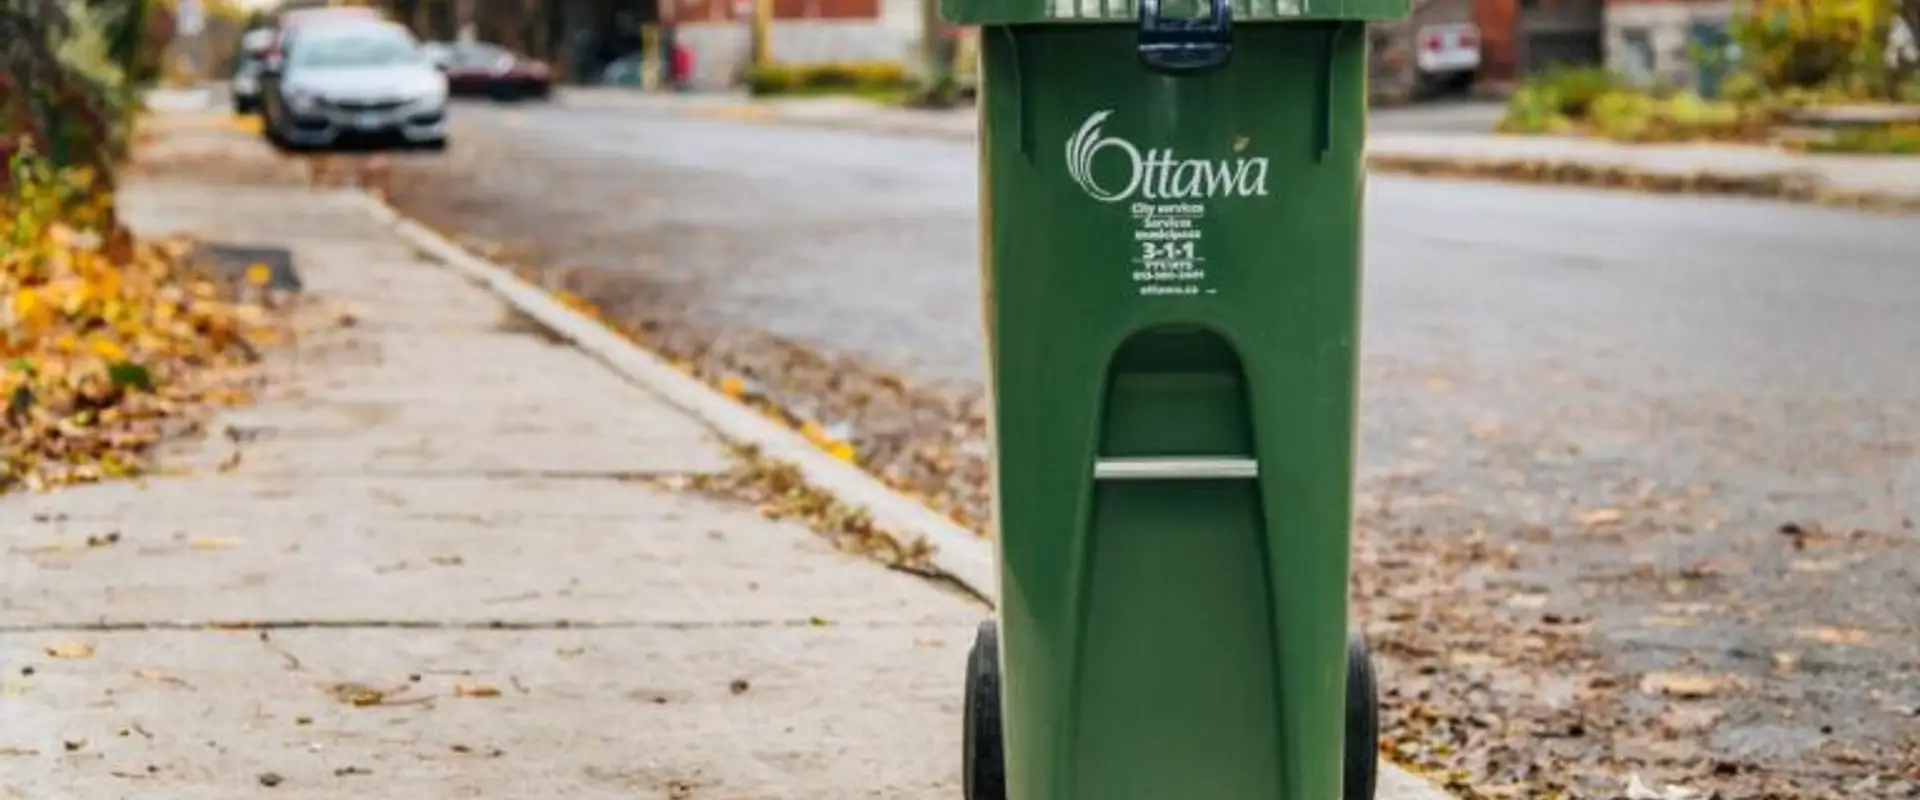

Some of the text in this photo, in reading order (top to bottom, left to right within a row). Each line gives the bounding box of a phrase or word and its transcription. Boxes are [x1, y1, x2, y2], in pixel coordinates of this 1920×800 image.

[1065, 110, 1269, 201] Ottawa
[1132, 203, 1204, 217] City services
[1142, 242, 1194, 259] 3-1-1
